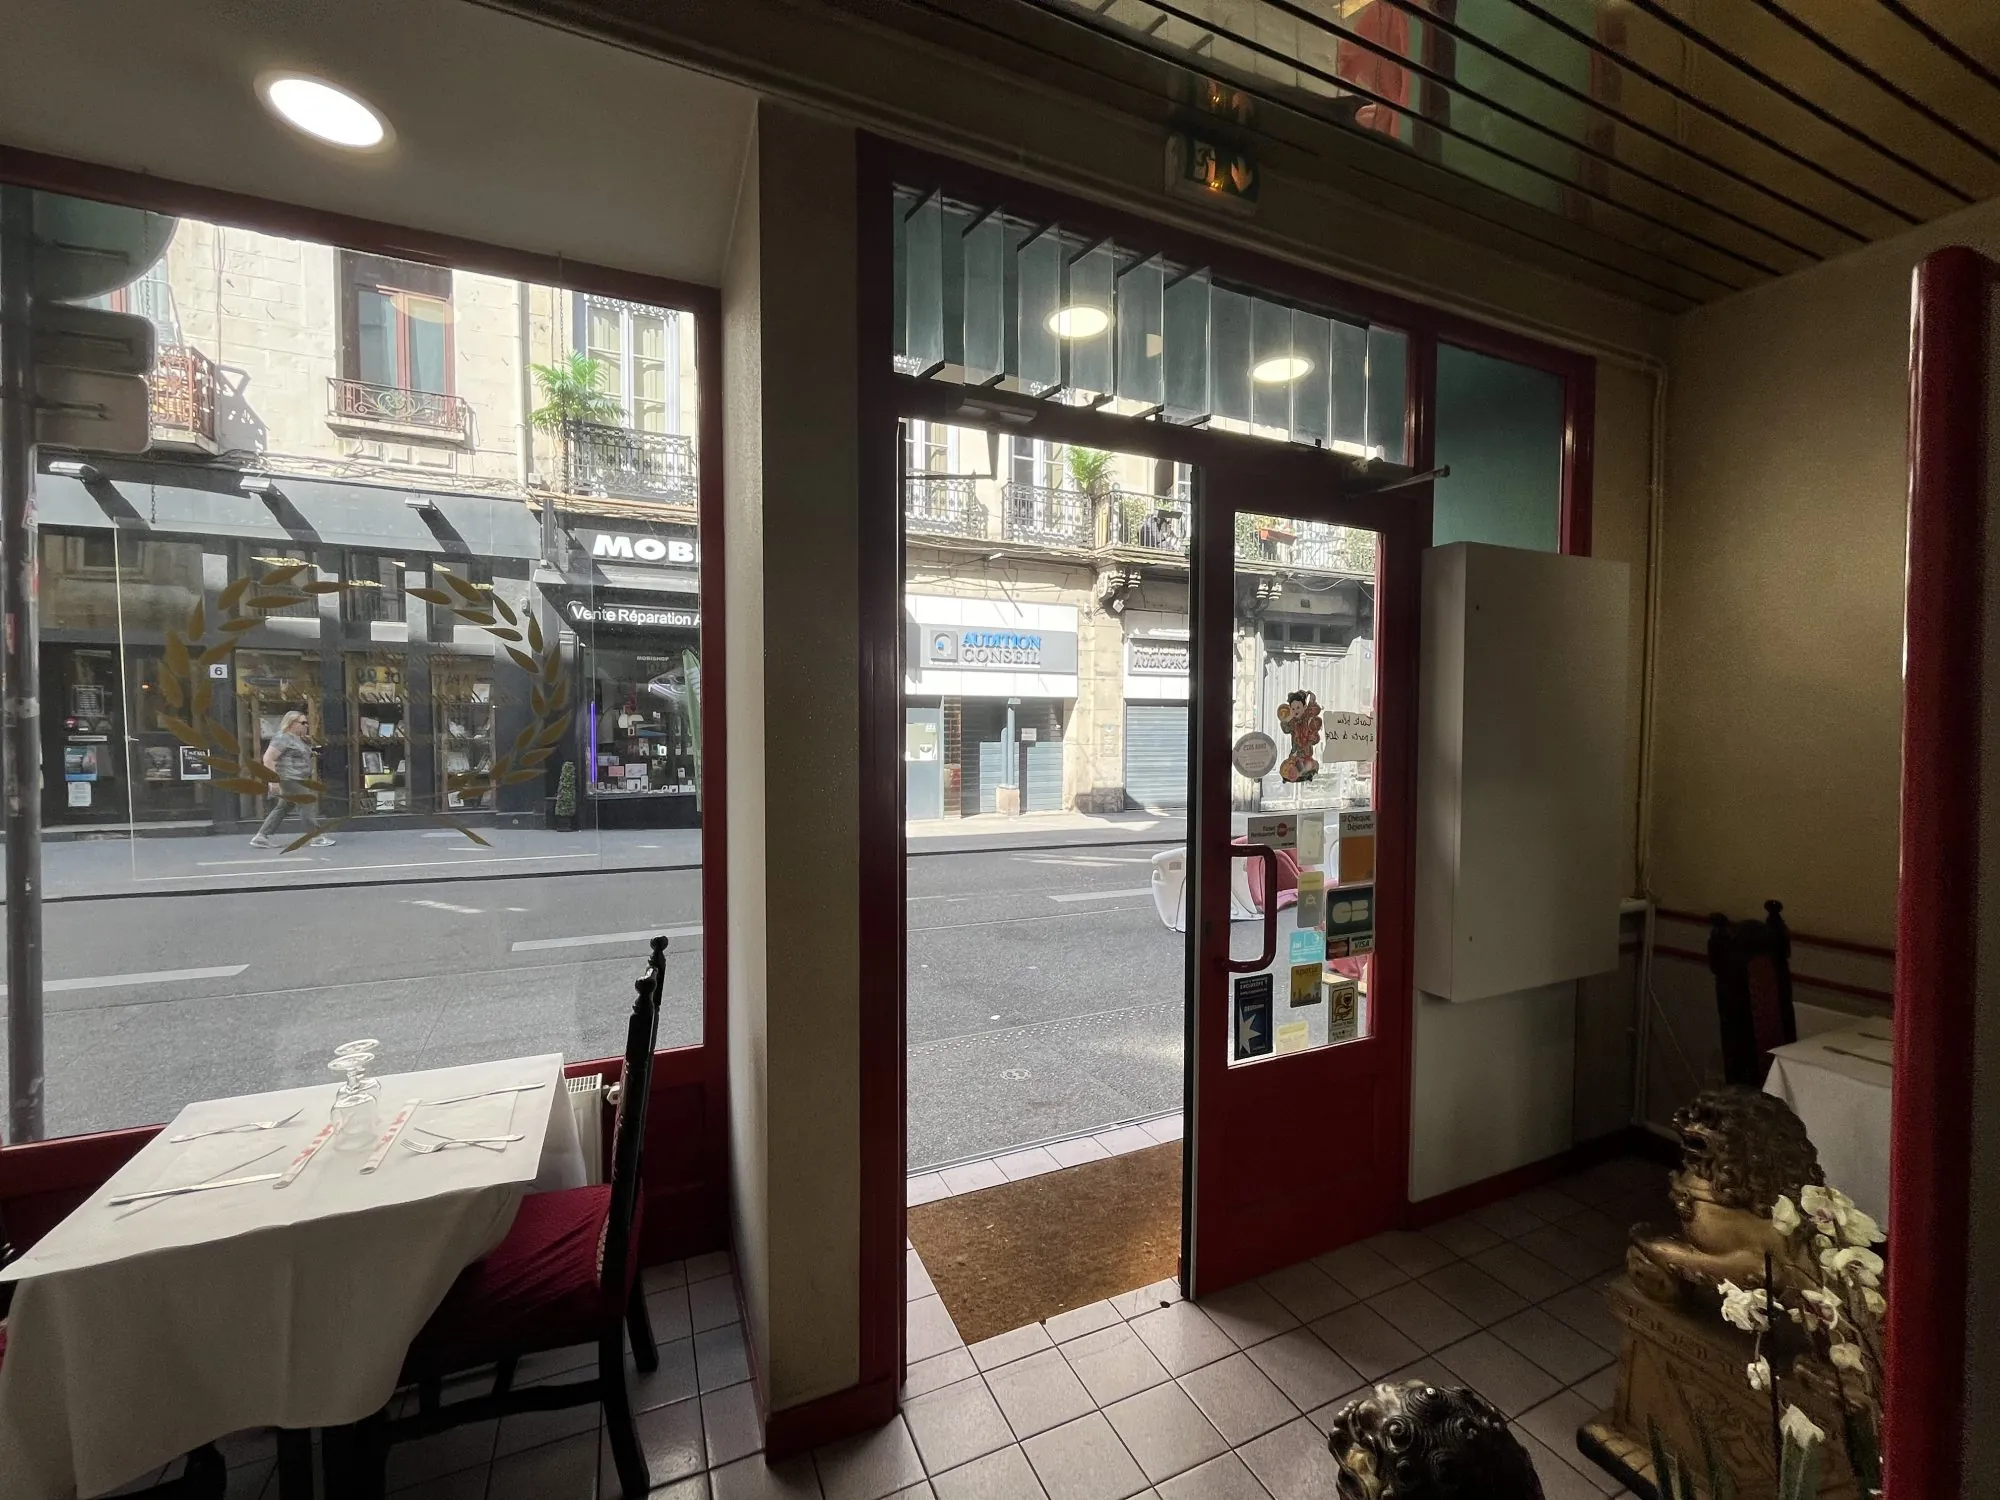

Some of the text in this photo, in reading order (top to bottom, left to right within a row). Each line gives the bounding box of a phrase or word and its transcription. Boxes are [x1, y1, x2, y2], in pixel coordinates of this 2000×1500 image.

[572, 605, 616, 621] Vente
[618, 609, 692, 626] Réparation
[962, 631, 1042, 650] AUDITION
[962, 649, 1041, 665] CONSEIL
[214, 666, 223, 677] 6
